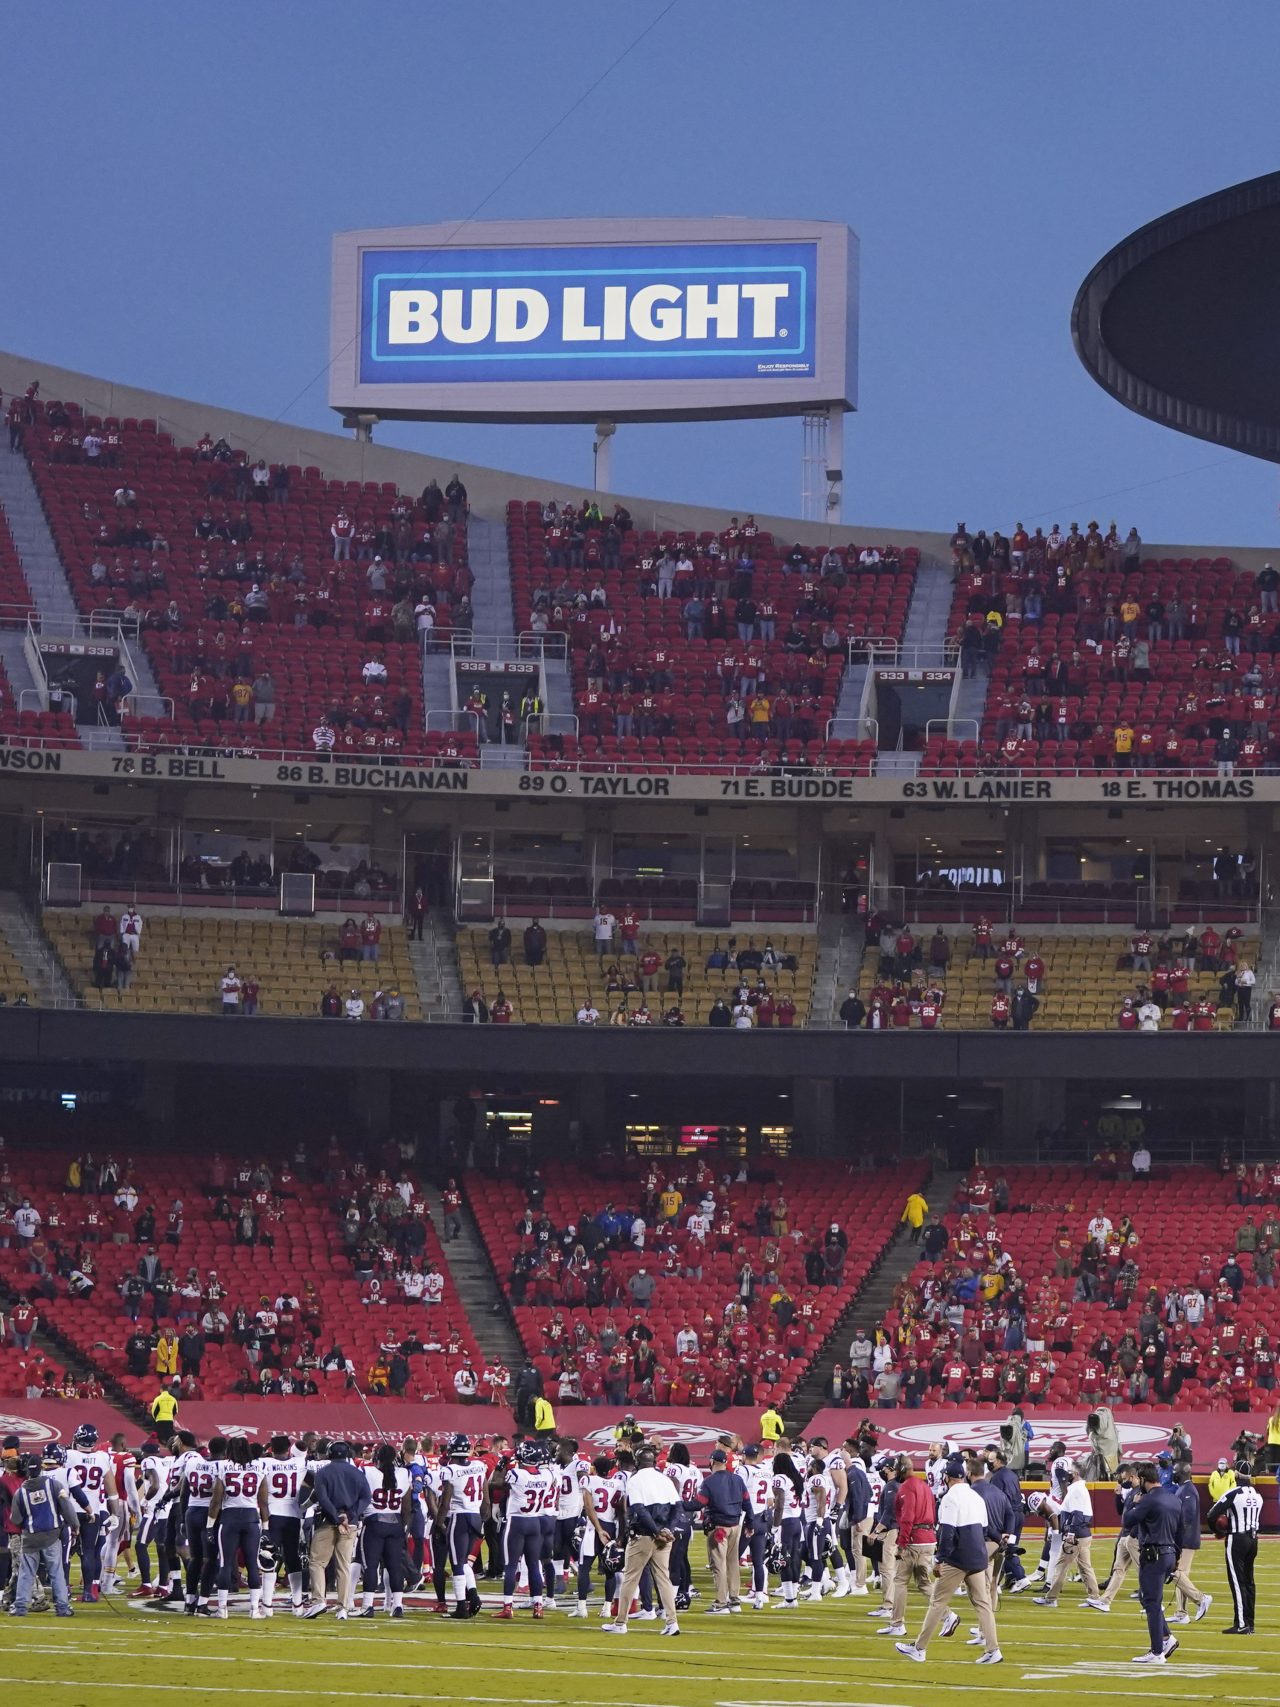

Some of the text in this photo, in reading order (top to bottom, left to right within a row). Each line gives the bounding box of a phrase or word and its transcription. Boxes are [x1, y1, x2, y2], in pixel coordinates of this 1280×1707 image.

[389, 283, 788, 344] BUD LIGHT
[974, 578, 982, 586] 15
[373, 608, 382, 616] 15
[40, 643, 113, 656] 331 332
[656, 653, 665, 662] 15
[461, 663, 534, 673] 332 333
[880, 672, 952, 680] 333 334
[112, 758, 225, 779] 78 B. BELL
[277, 766, 468, 790] 86 B. BUCHANAN
[519, 775, 544, 791] 89
[579, 777, 669, 796] TAYLOR
[721, 779, 853, 798] 71 E. BUDDE
[903, 781, 1052, 798] 63 W. LANIER
[1102, 780, 1254, 798] 18 E. THOMAS
[923, 1007, 935, 1016] 25
[413, 1204, 424, 1213] 32
[803, 1305, 812, 1316] 15
[920, 1330, 930, 1340] 15
[1223, 1326, 1234, 1336] 15
[950, 1368, 962, 1377] 29
[982, 1368, 994, 1378] 55
[1030, 1373, 1040, 1382] 15
[1085, 1369, 1096, 1379] 15
[74, 1465, 102, 1490] 99
[226, 1473, 257, 1497] 58
[272, 1473, 297, 1498] 91
[464, 1476, 483, 1501] 41
[757, 1480, 767, 1504] 2
[373, 1488, 402, 1510] 96
[520, 1490, 544, 1512] 31
[594, 1488, 621, 1512] 34
